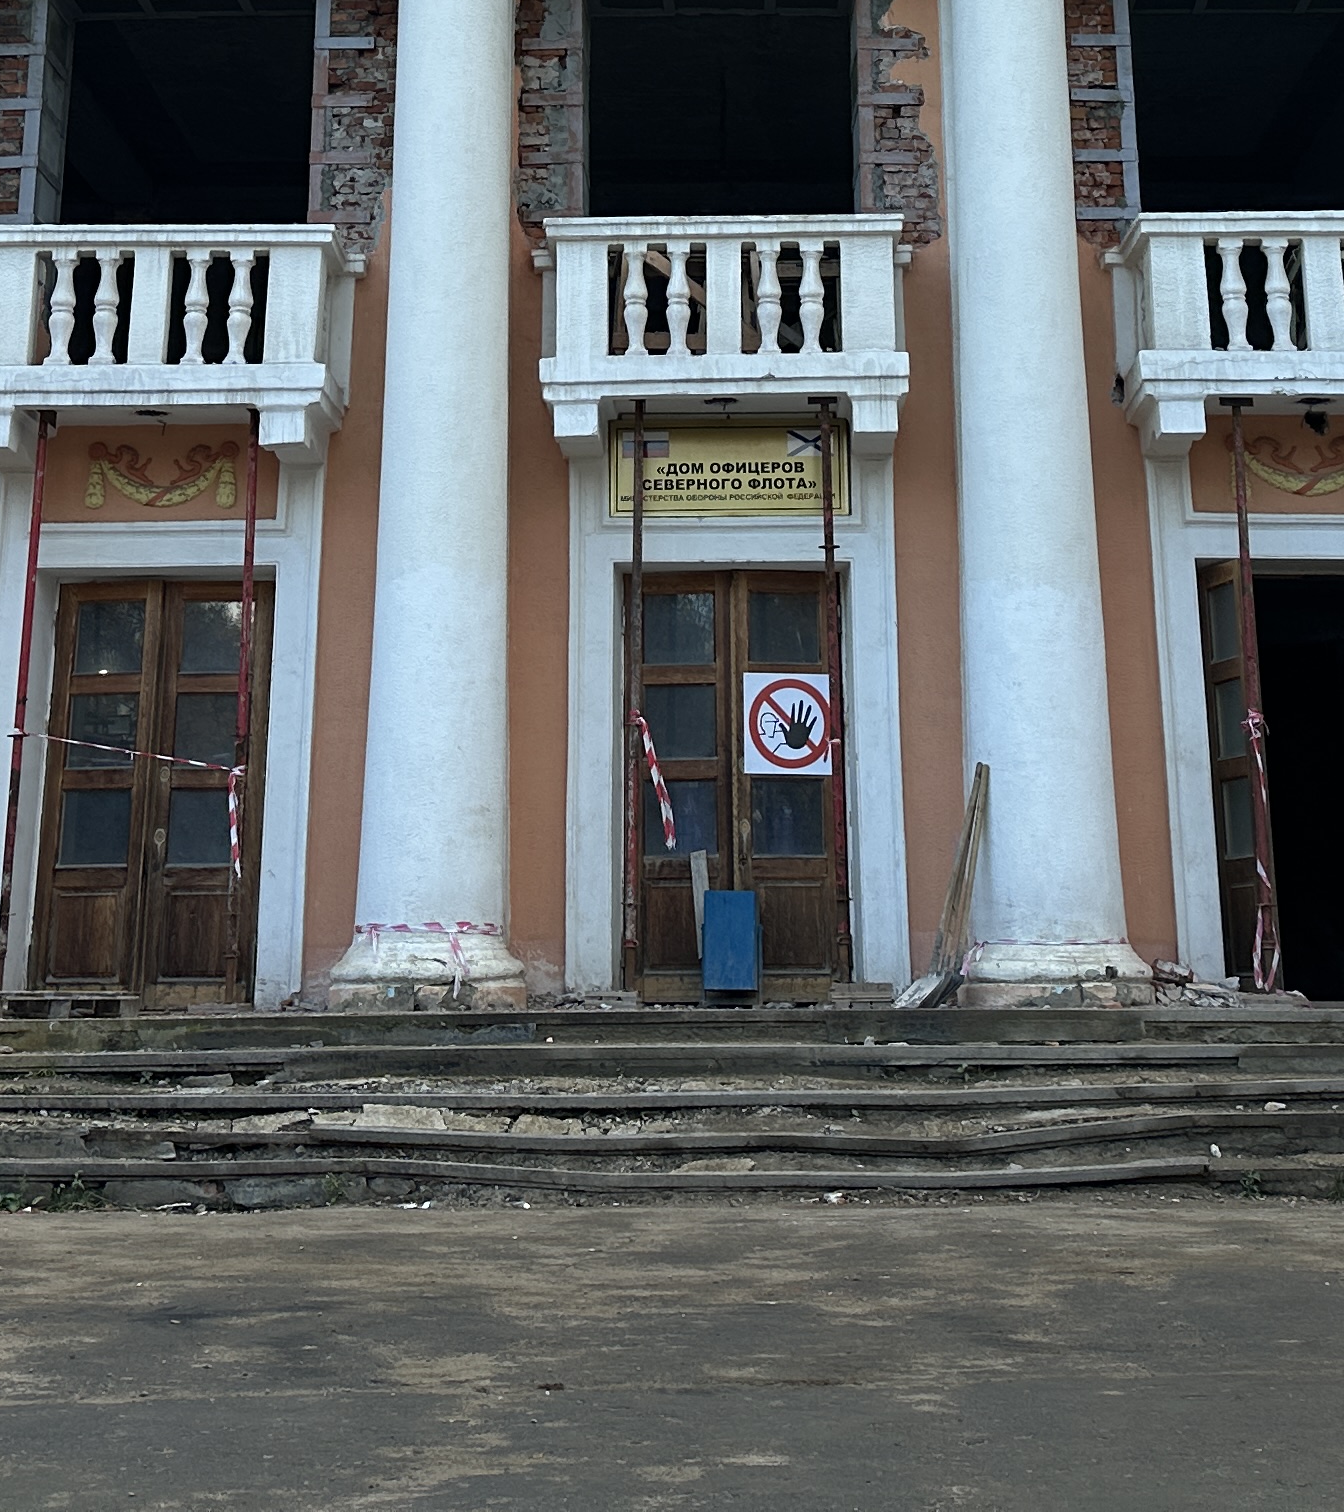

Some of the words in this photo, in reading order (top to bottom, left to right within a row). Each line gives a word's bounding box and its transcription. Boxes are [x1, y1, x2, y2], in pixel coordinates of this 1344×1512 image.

[656, 462, 704, 477] «ДОМ
[709, 461, 805, 476] ОФИЦЕРОВ
[642, 478, 743, 491] СЕВЕРНОГО
[747, 477, 817, 491] ФЛОТА»
[620, 493, 684, 503] МИСТЕРСТВА
[685, 493, 728, 502] ОБОРОНЫ
[729, 491, 783, 502] РОССИЙСКОЙ
[786, 491, 836, 501] ФЕДЕРАЦИ
